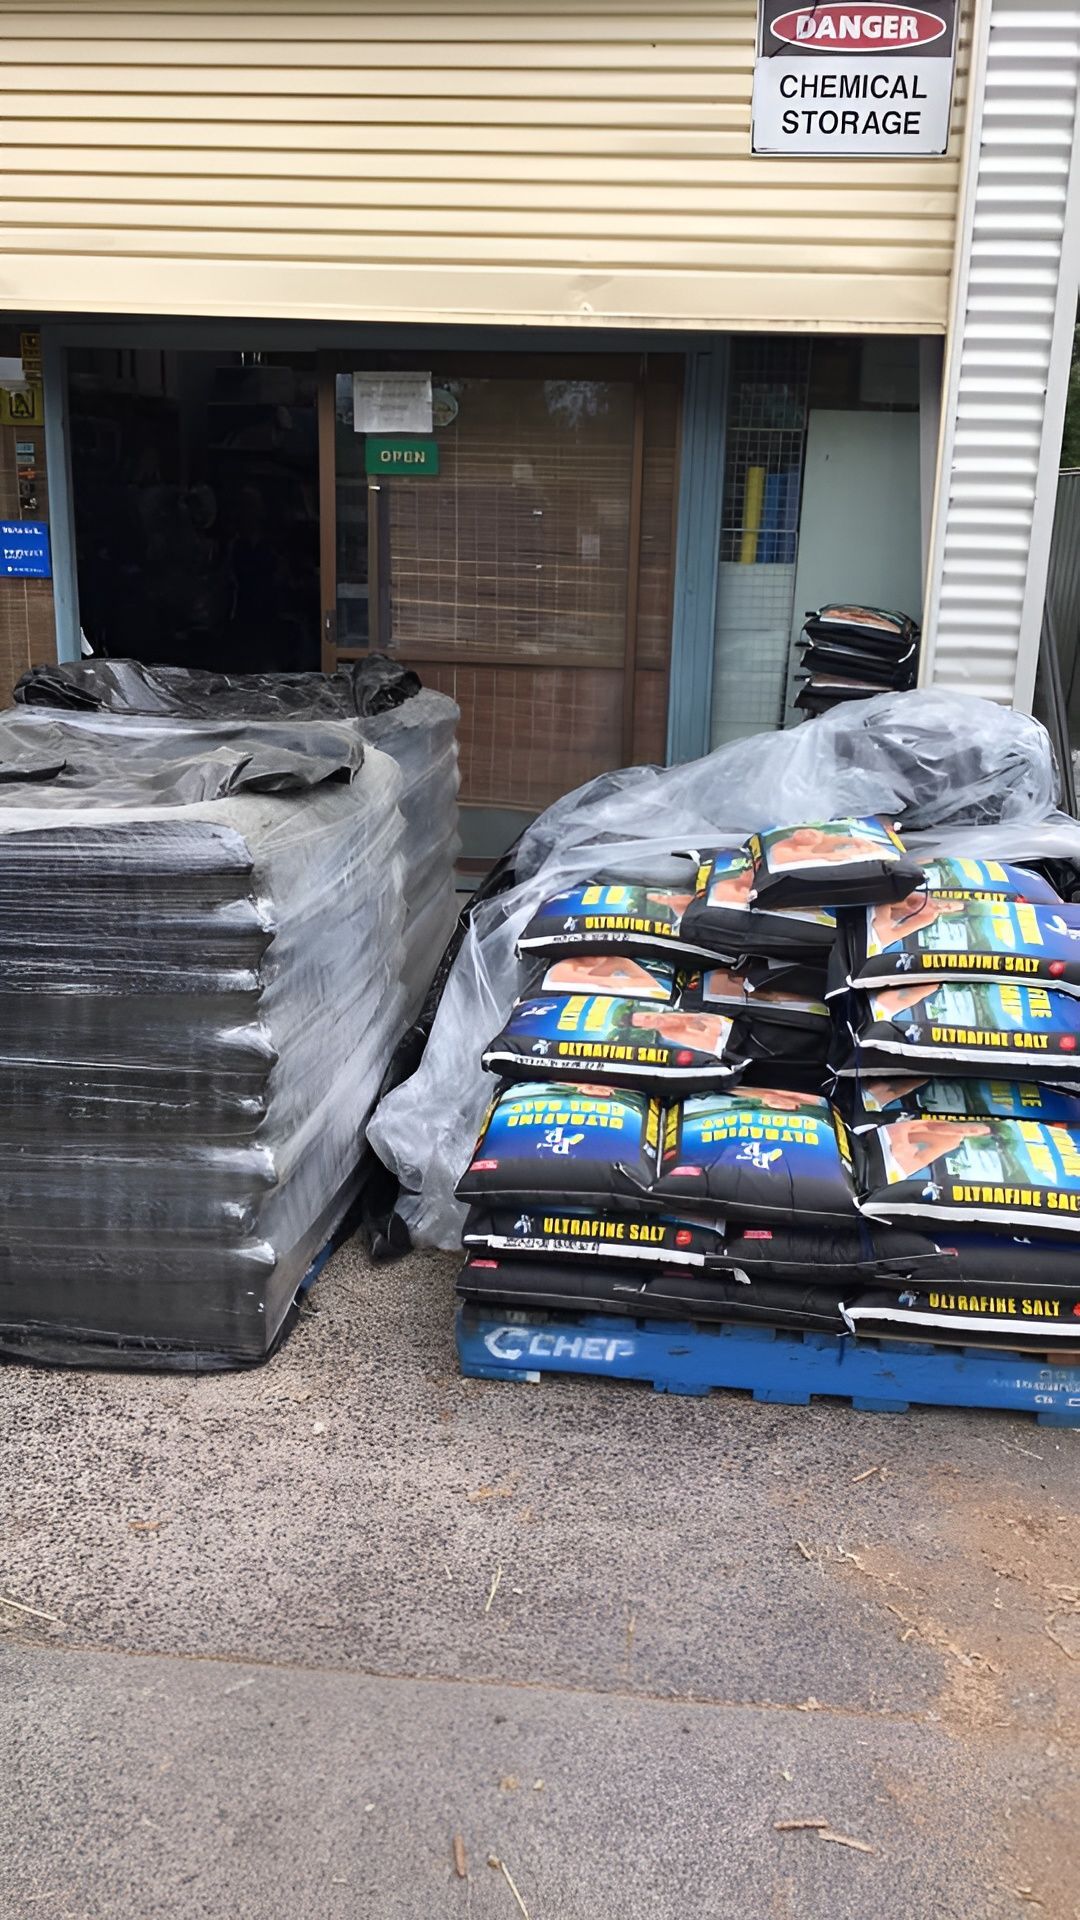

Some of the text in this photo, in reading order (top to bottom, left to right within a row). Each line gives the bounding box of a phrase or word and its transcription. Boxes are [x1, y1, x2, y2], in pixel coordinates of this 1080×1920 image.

[796, 15, 919, 39] DANGER
[780, 74, 928, 99] CHEMICAL
[782, 110, 921, 135] STORAGE
[380, 450, 425, 463] OPEN
[585, 916, 651, 932] ULTRAFINE
[922, 953, 1040, 972] ULTRAFINE SALT
[931, 1026, 1049, 1049] ULTRAFINE SALT
[558, 1041, 670, 1063] ULTRAFINE SALT
[952, 1185, 1042, 1207] ULTRAFINE
[543, 1217, 667, 1242] ULTRAFINE SALT
[929, 1292, 1060, 1317] ULTRAFINE SALT
